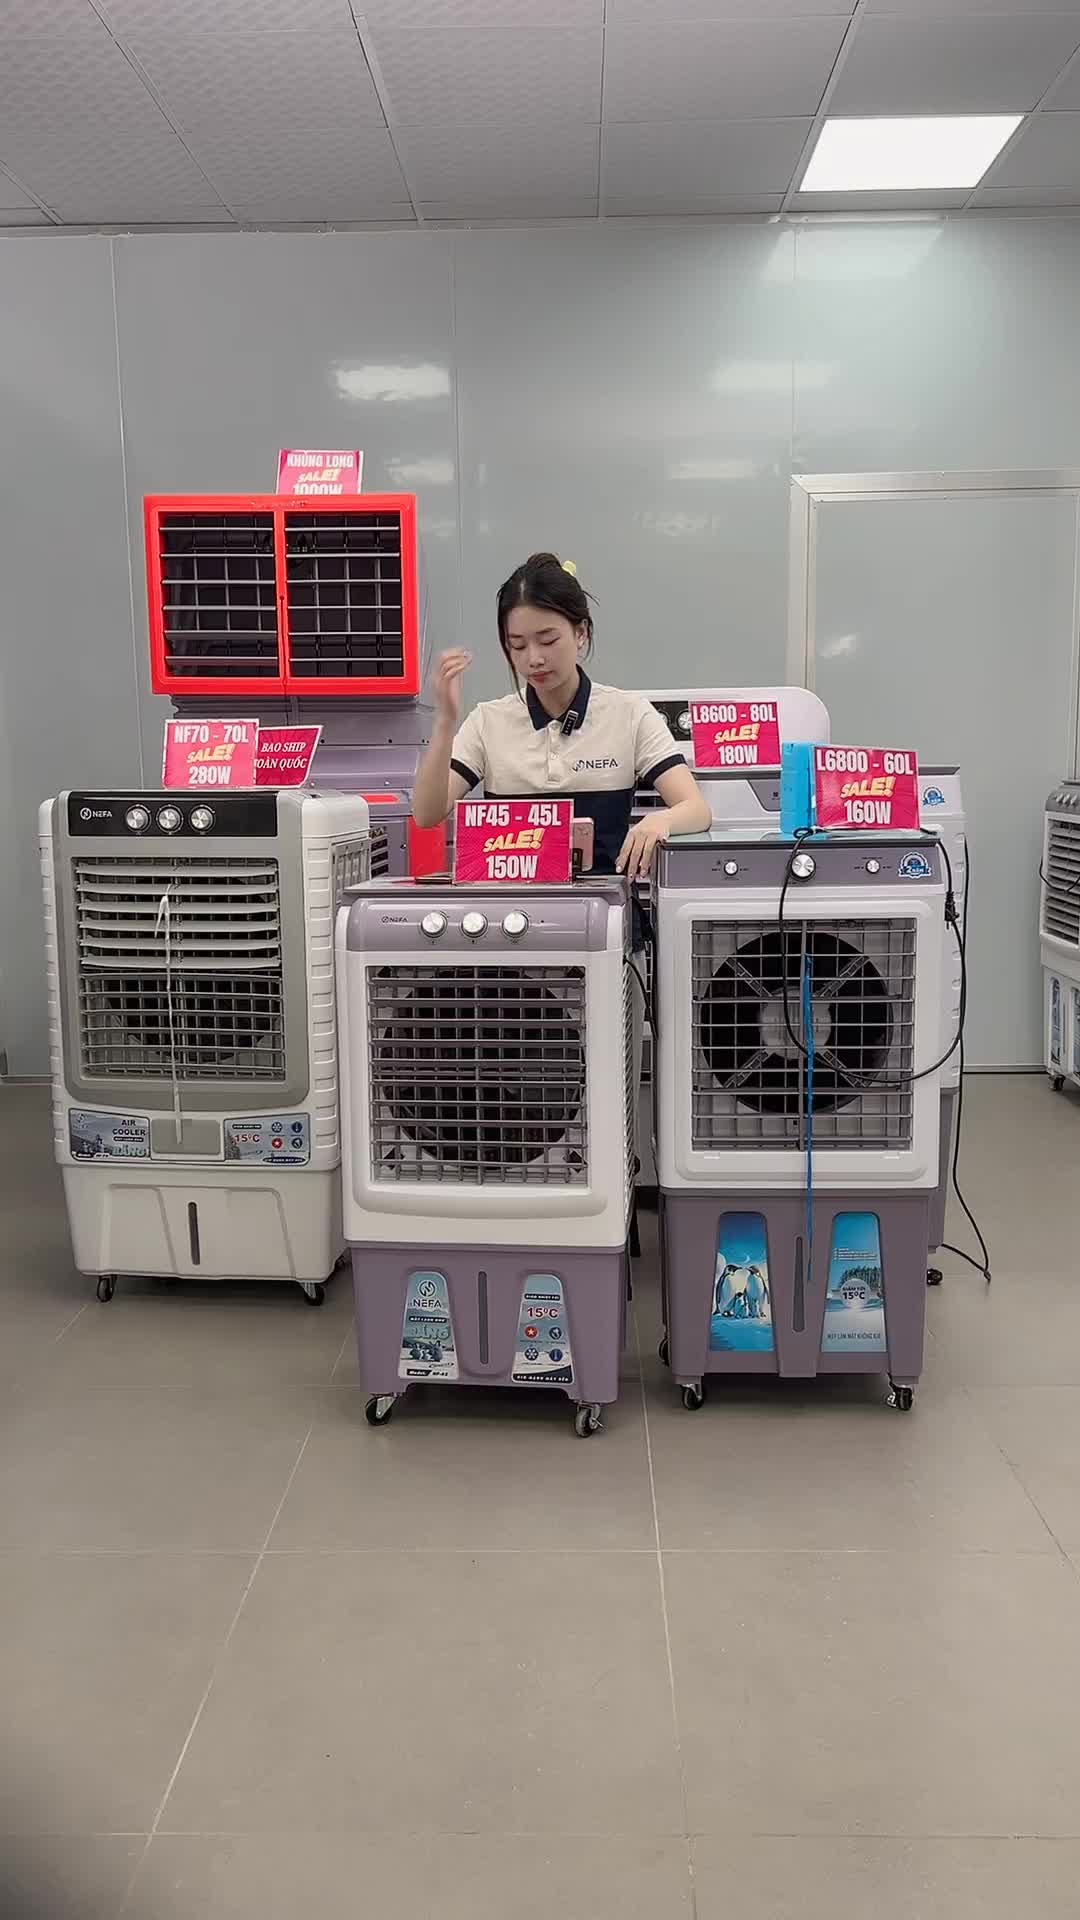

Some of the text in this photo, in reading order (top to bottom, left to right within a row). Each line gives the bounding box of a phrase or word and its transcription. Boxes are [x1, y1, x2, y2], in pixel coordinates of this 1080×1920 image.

[326, 455, 354, 468] LONG
[692, 704, 737, 724] L8600
[750, 703, 776, 722] 80L
[173, 725, 209, 744] NF70
[224, 724, 249, 744] 70L
[714, 723, 760, 744] SALE!
[186, 744, 236, 764] SALE!
[260, 742, 306, 752] BAO SHIP
[718, 744, 758, 765] 180W
[279, 755, 308, 771] QUỐC
[586, 758, 618, 768] NEFA
[816, 748, 868, 773] L6800
[884, 752, 914, 775] 60L
[188, 765, 232, 785] 280W
[840, 776, 897, 798] SALE!
[465, 804, 510, 827] NF45
[527, 804, 562, 826] 45L
[844, 799, 892, 824] 160W
[483, 828, 545, 853] SALE!
[486, 855, 538, 879] 150W
[112, 1128, 146, 1136] COOLER
[413, 1299, 442, 1308] NEFA
